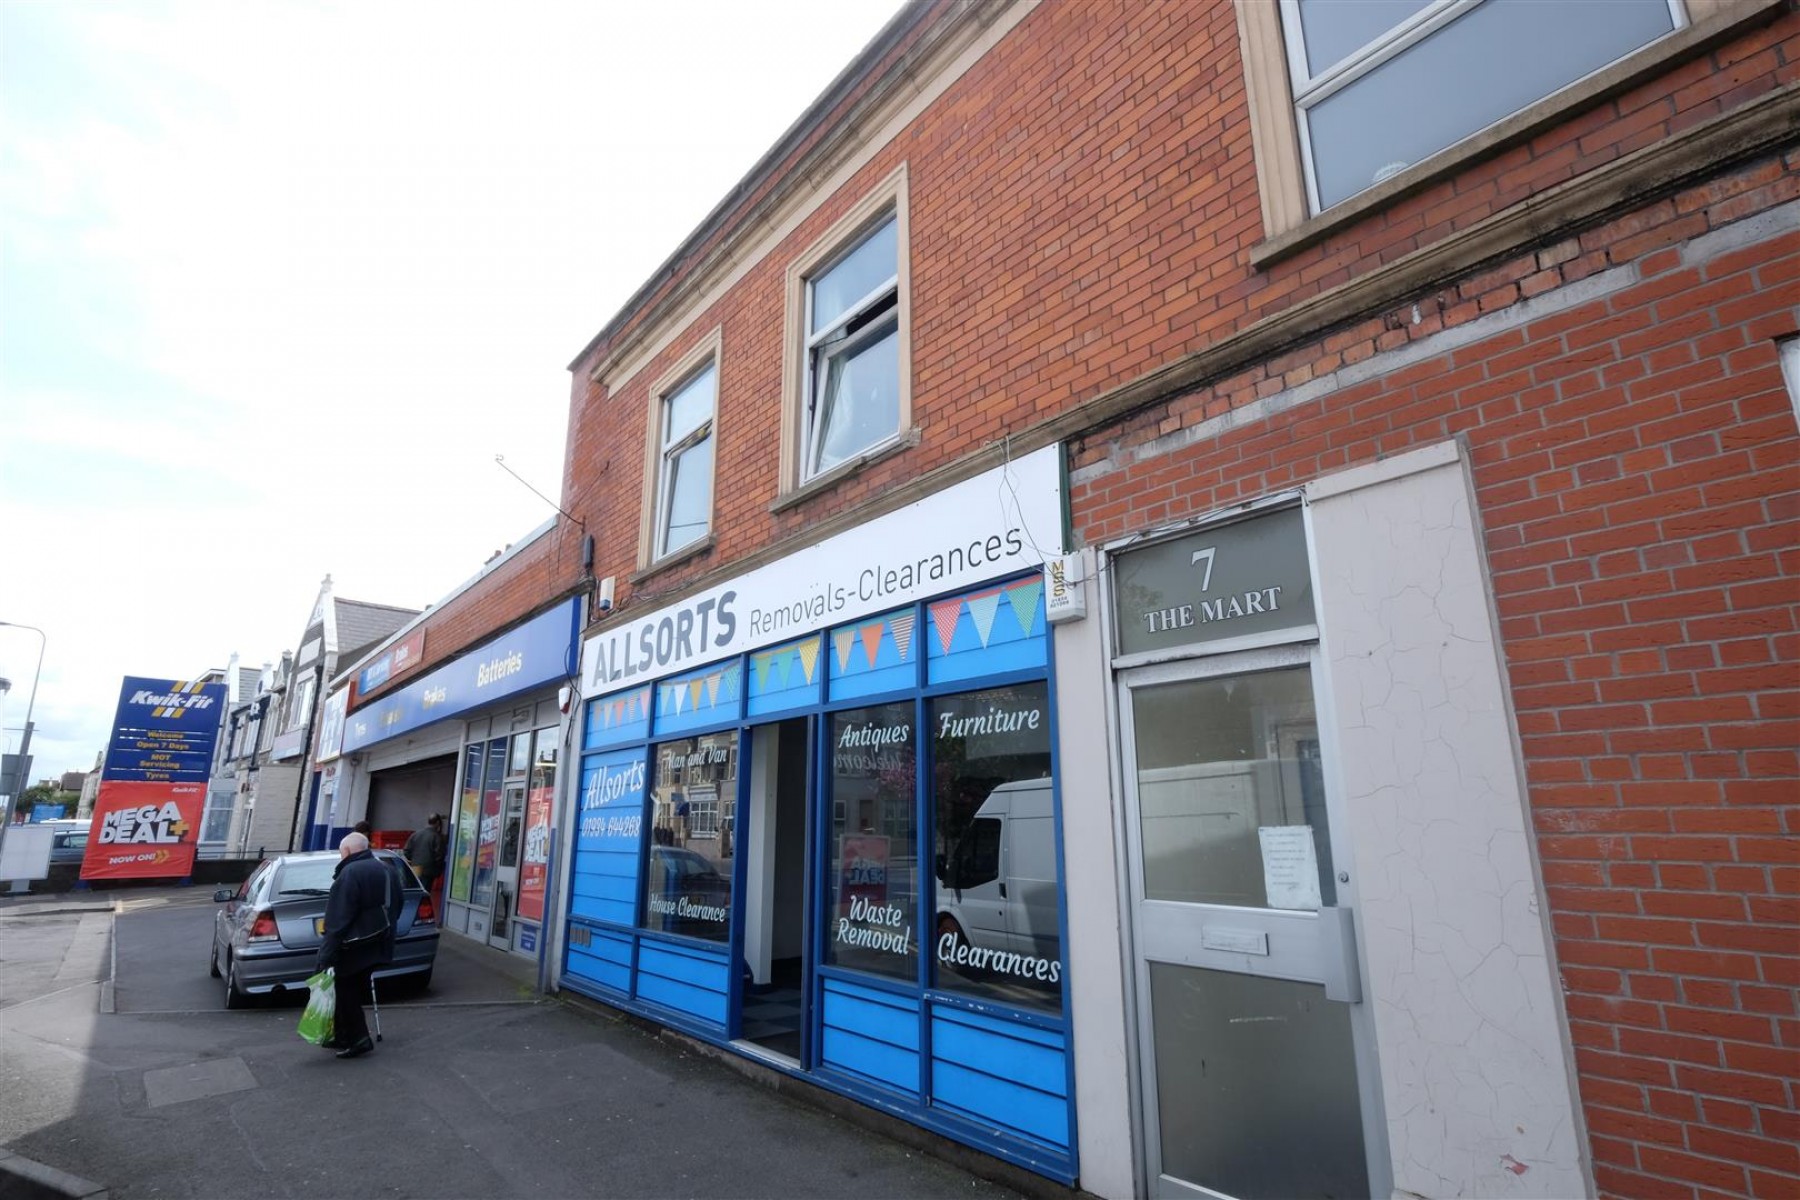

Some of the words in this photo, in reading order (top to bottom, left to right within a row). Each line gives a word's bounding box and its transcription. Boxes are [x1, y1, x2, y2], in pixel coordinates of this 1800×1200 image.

[1191, 547, 1216, 592] 7
[1143, 605, 1194, 634] THE
[1200, 586, 1281, 623] MART
[592, 590, 738, 688] ALLSORTS
[477, 651, 523, 688] Batteries
[129, 690, 214, 709] Kwik-Fit
[838, 722, 909, 752] Antiques
[940, 707, 1040, 738] Furniture
[136, 741, 159, 750] Open
[161, 742, 167, 750] 7
[169, 742, 190, 751] Days
[687, 751, 705, 767] and
[708, 745, 728, 764] Van
[140, 761, 180, 770] Servicing
[146, 771, 170, 780] Tyres
[583, 760, 645, 811] Allsorts
[103, 801, 182, 827] MEGA
[109, 855, 136, 865] NOW
[650, 893, 675, 915] House
[678, 897, 726, 923] Clearance
[850, 895, 902, 927] Waste
[836, 918, 910, 955] Removal
[937, 932, 1061, 983] Clearances
